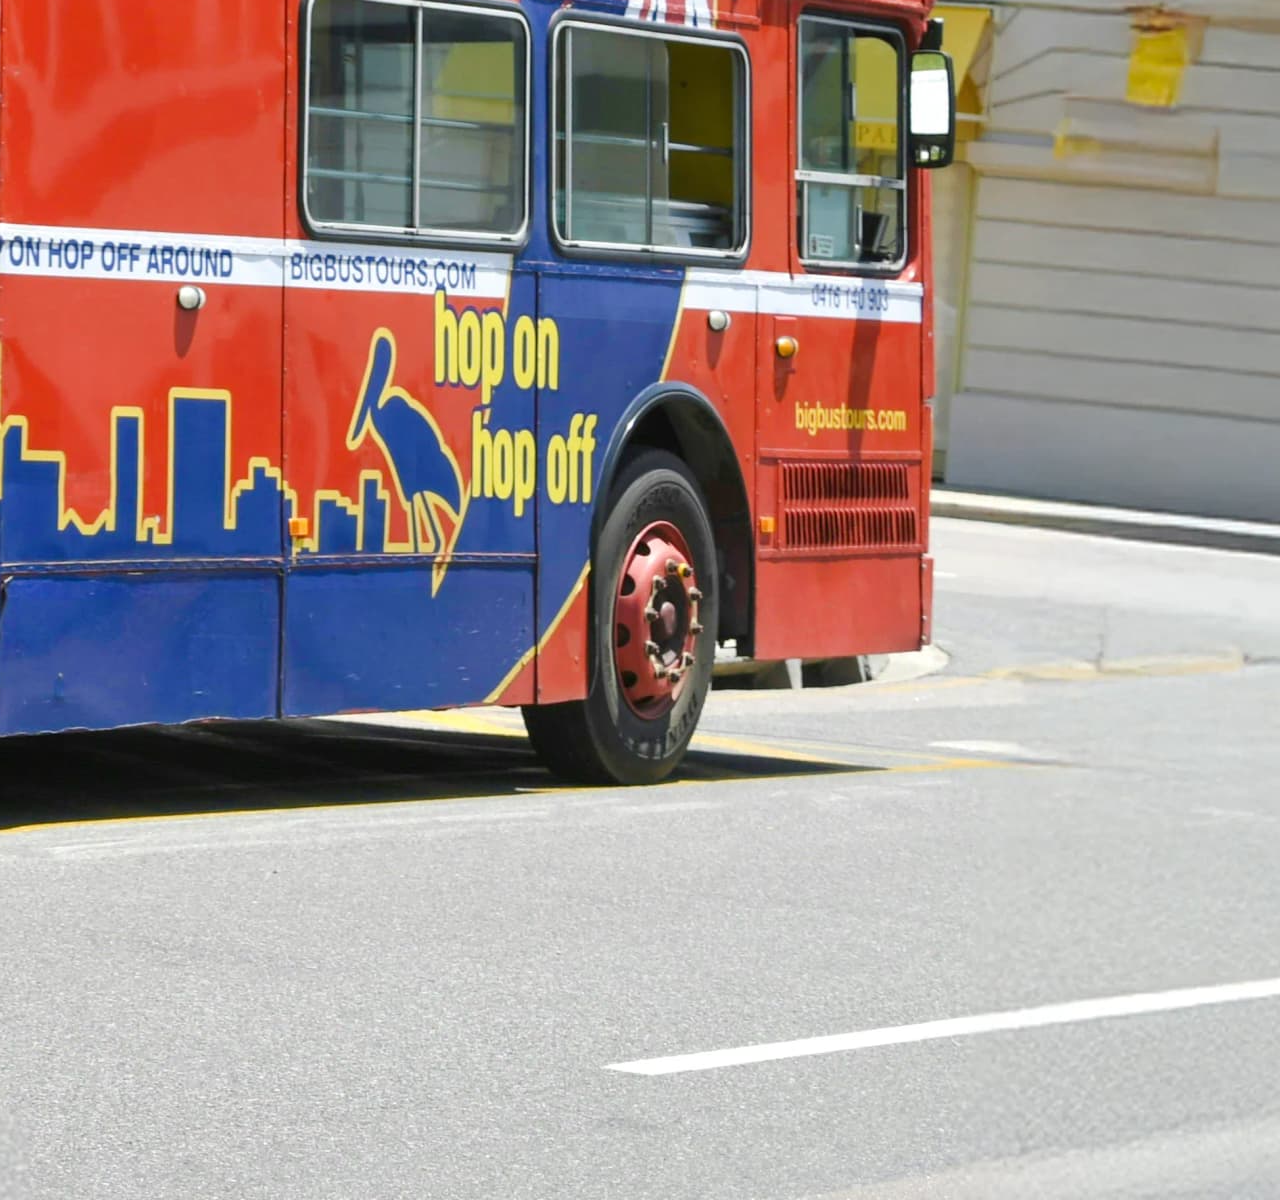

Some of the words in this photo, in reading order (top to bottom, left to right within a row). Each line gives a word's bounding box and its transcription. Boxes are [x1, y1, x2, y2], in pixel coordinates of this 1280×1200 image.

[9, 236, 41, 267] ON
[48, 238, 94, 270] HOP
[101, 241, 142, 273] OFF
[147, 245, 233, 278] AROUND
[290, 253, 477, 290] BIGBUSTOURS.COM
[434, 289, 505, 405] hop
[513, 315, 560, 391] on
[795, 401, 907, 436] bigbustours.com
[471, 410, 536, 517] hop
[547, 413, 598, 505] off
